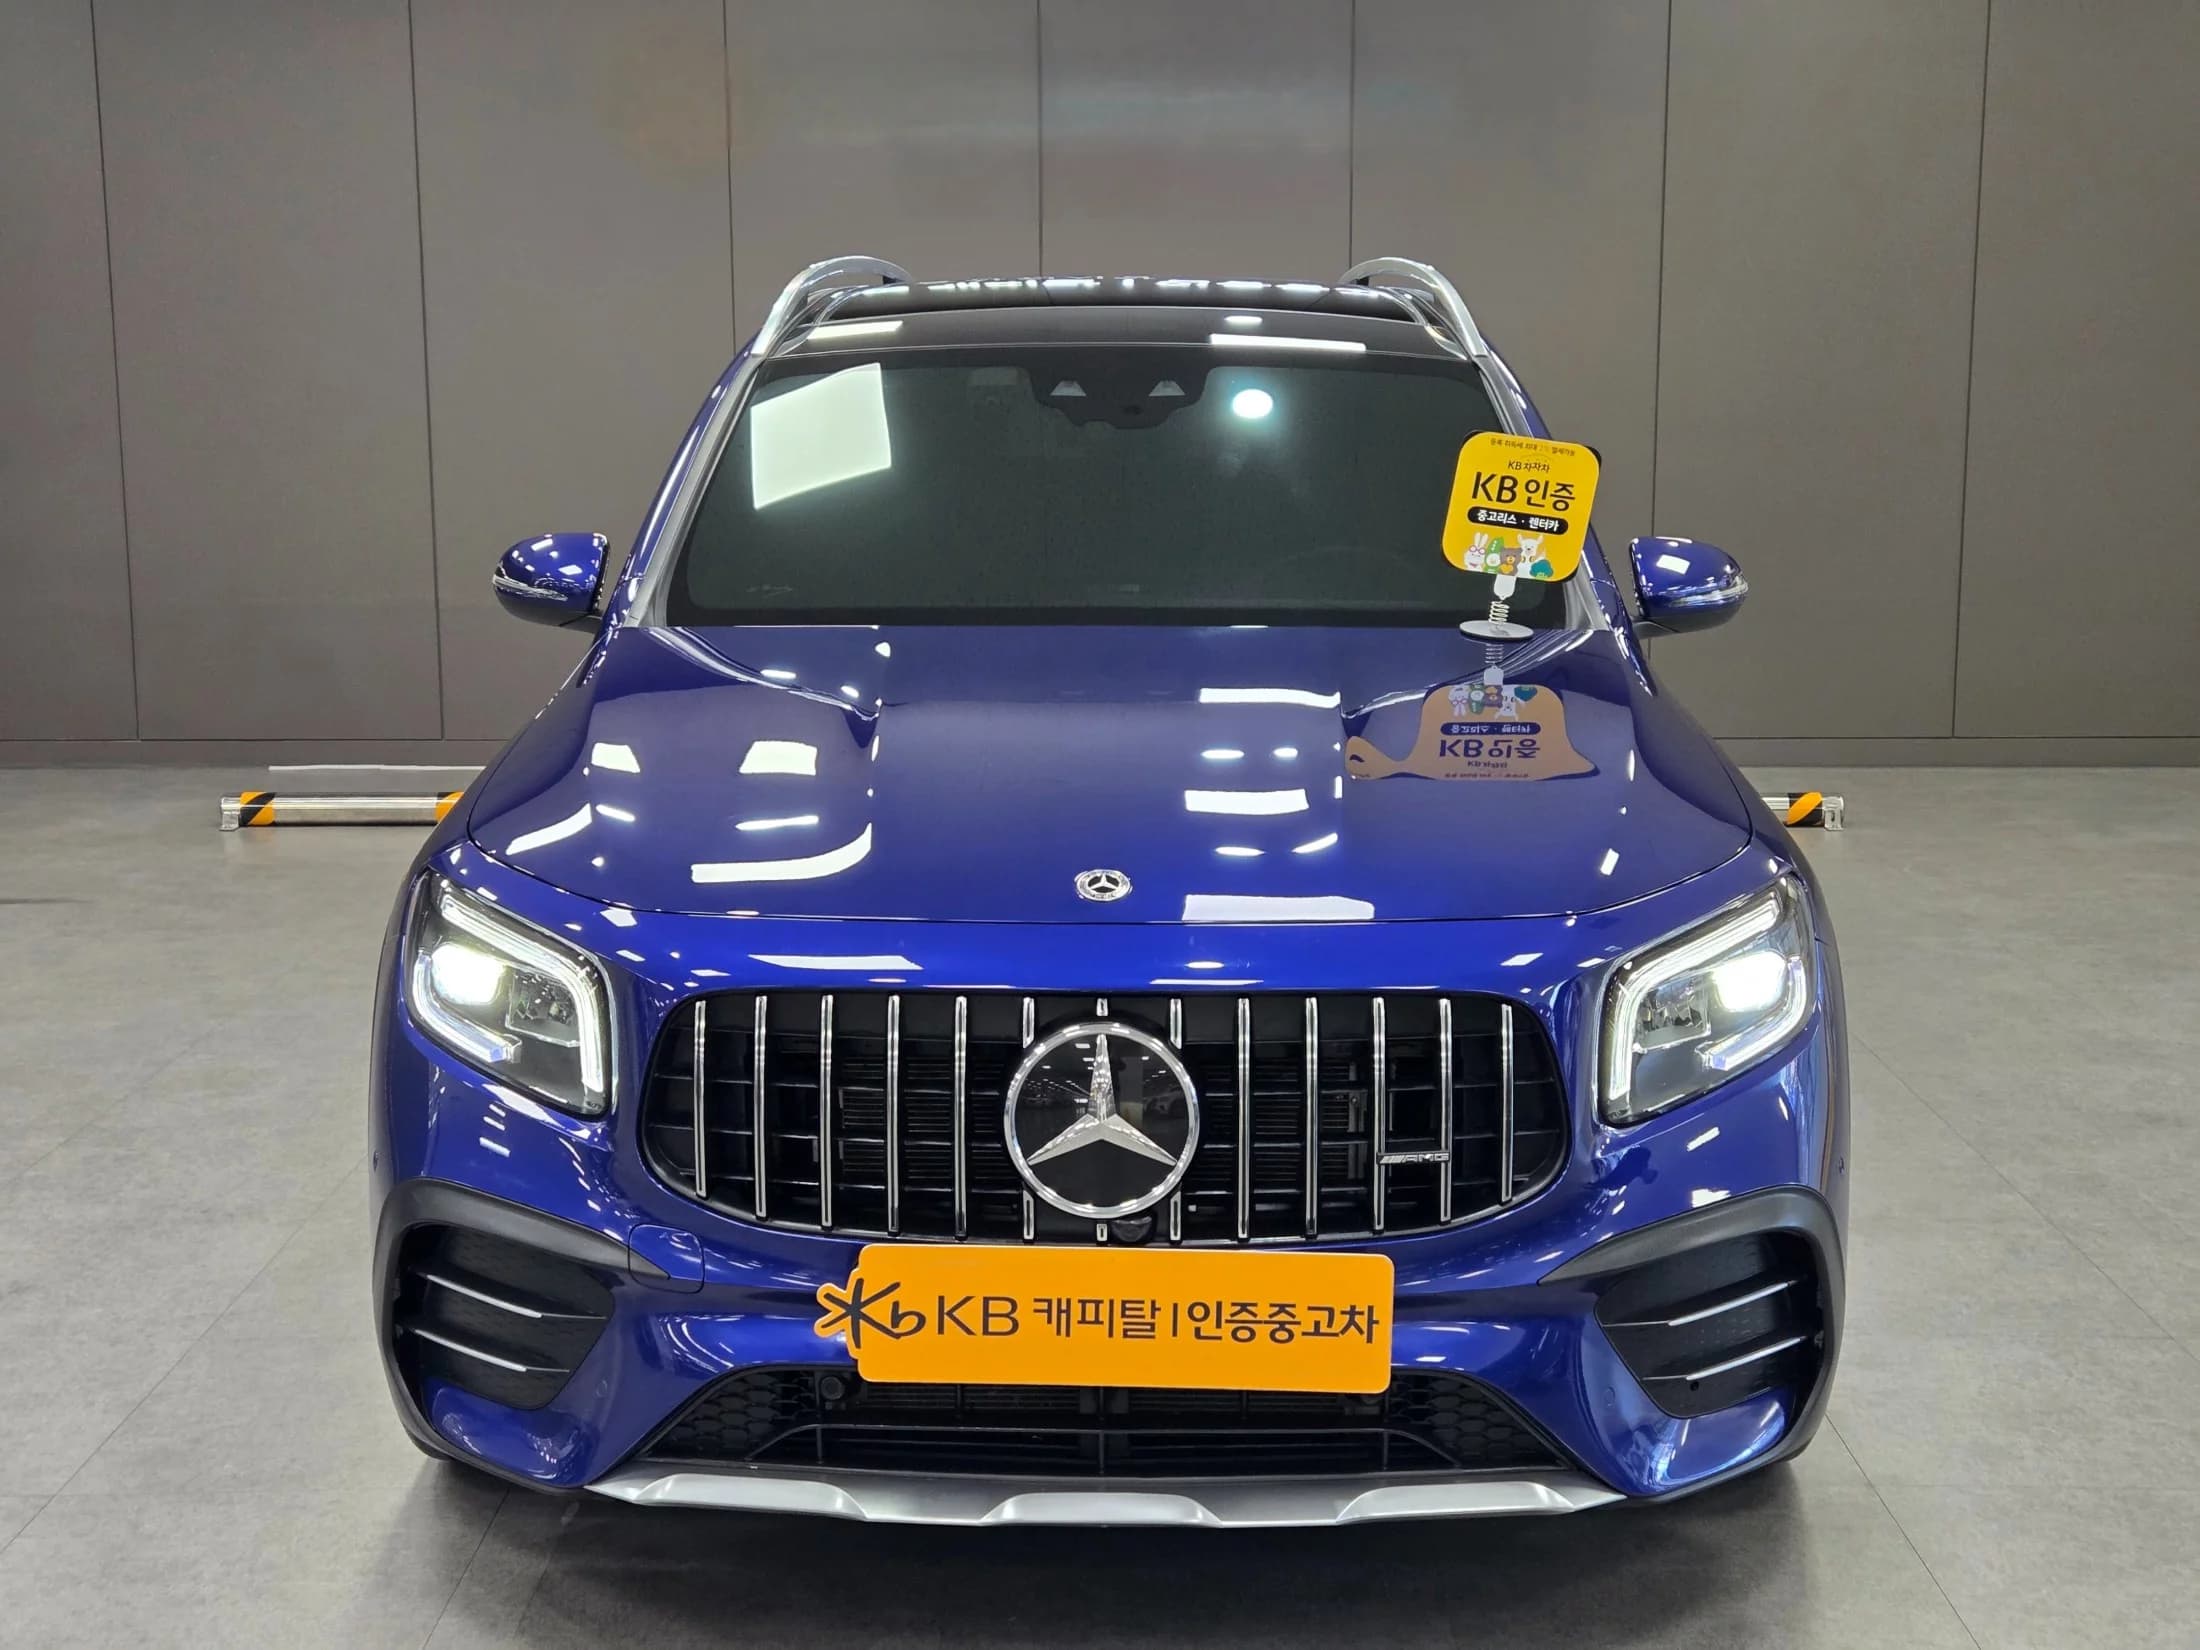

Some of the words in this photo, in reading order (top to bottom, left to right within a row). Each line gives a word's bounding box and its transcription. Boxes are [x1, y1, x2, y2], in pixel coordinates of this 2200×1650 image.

[1508, 460, 1521, 470] KB
[1472, 471, 1519, 504] KB
[1525, 479, 1576, 512] 인증
[1476, 509, 1517, 525] 중고리스
[1528, 517, 1560, 532] 렌터카
[936, 1294, 1020, 1338] KB
[1032, 1296, 1161, 1341] 캐피탈
[1187, 1300, 1381, 1346] 인증중고차
